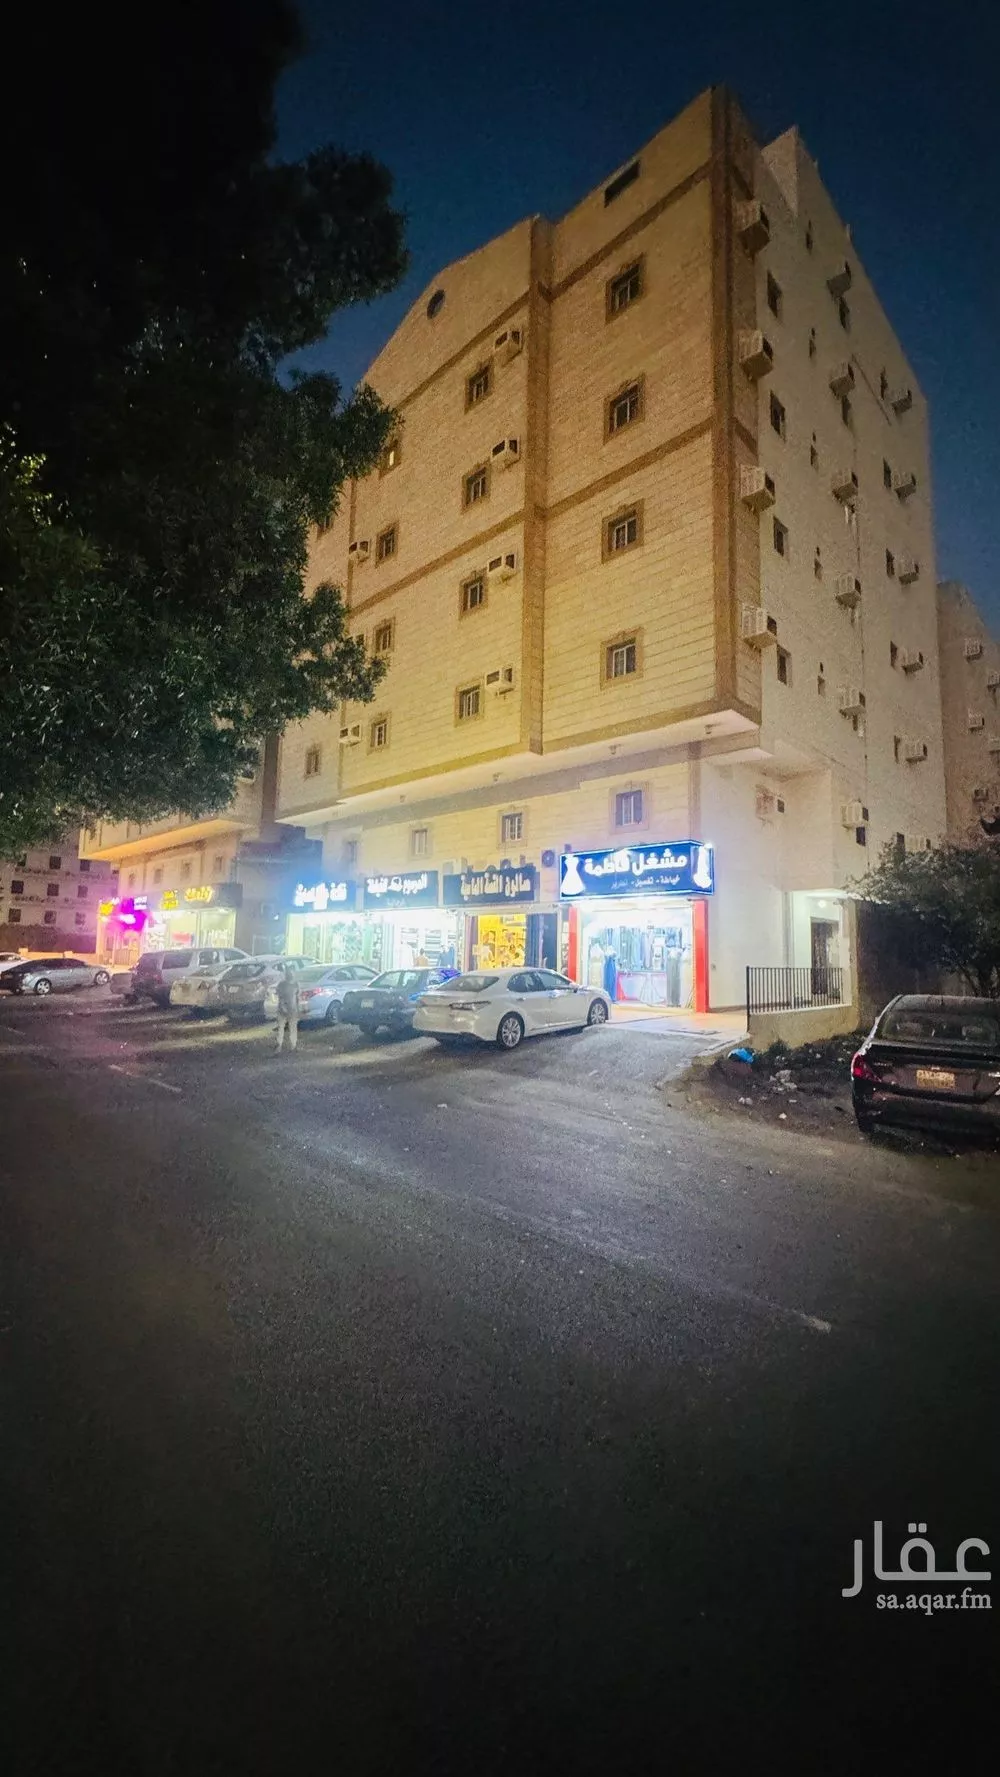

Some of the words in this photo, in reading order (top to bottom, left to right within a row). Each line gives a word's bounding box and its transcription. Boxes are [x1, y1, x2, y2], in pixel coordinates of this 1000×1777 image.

[584, 849, 630, 877] فاطمة
[632, 848, 687, 876] مشغل
[505, 873, 530, 897] صالون
